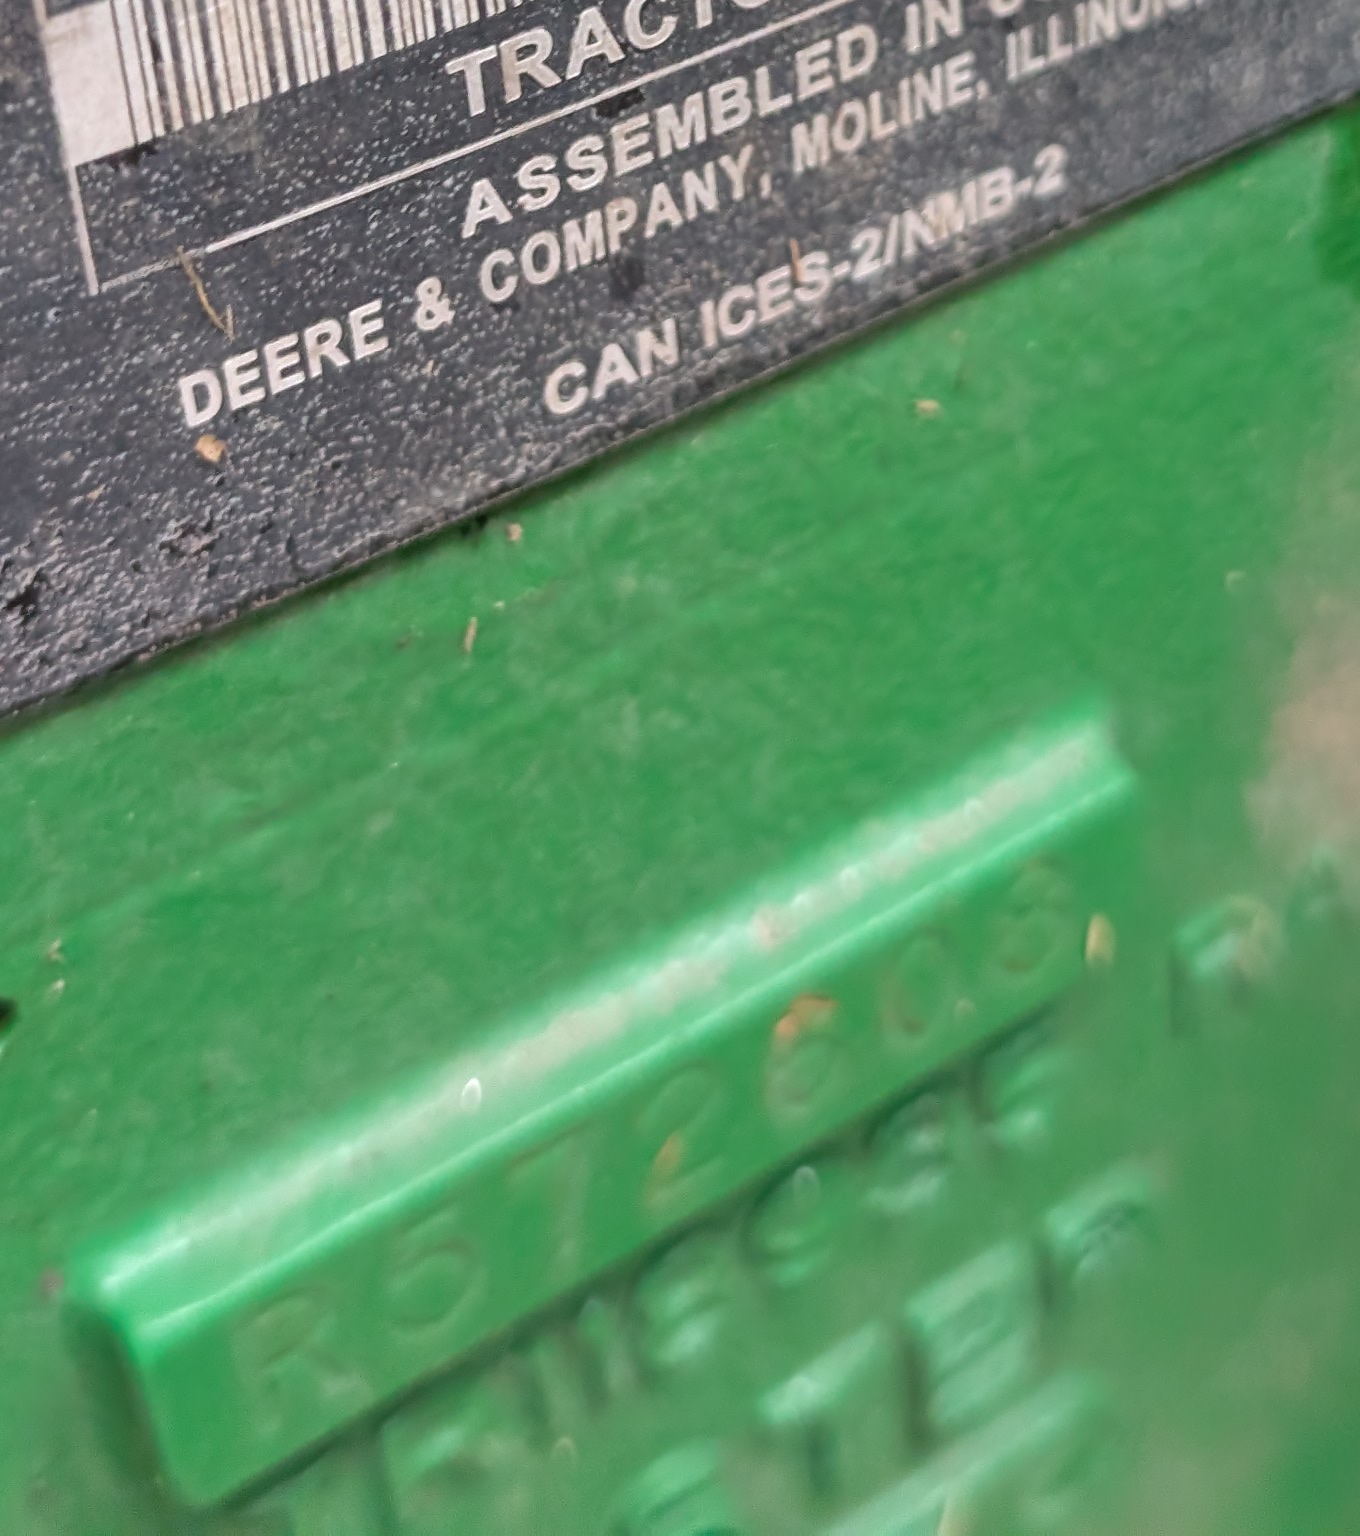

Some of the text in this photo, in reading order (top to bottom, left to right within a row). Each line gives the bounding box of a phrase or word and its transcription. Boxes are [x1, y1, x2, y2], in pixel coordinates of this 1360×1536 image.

[177, 298, 390, 428] DEERE
[413, 276, 456, 332] &
[479, 144, 772, 304] COMPANY,
[790, 53, 990, 175] MOLINE,
[460, 23, 879, 239] ASSEMBLED
[543, 143, 1069, 416] CAN ICES-2/NMB-2
